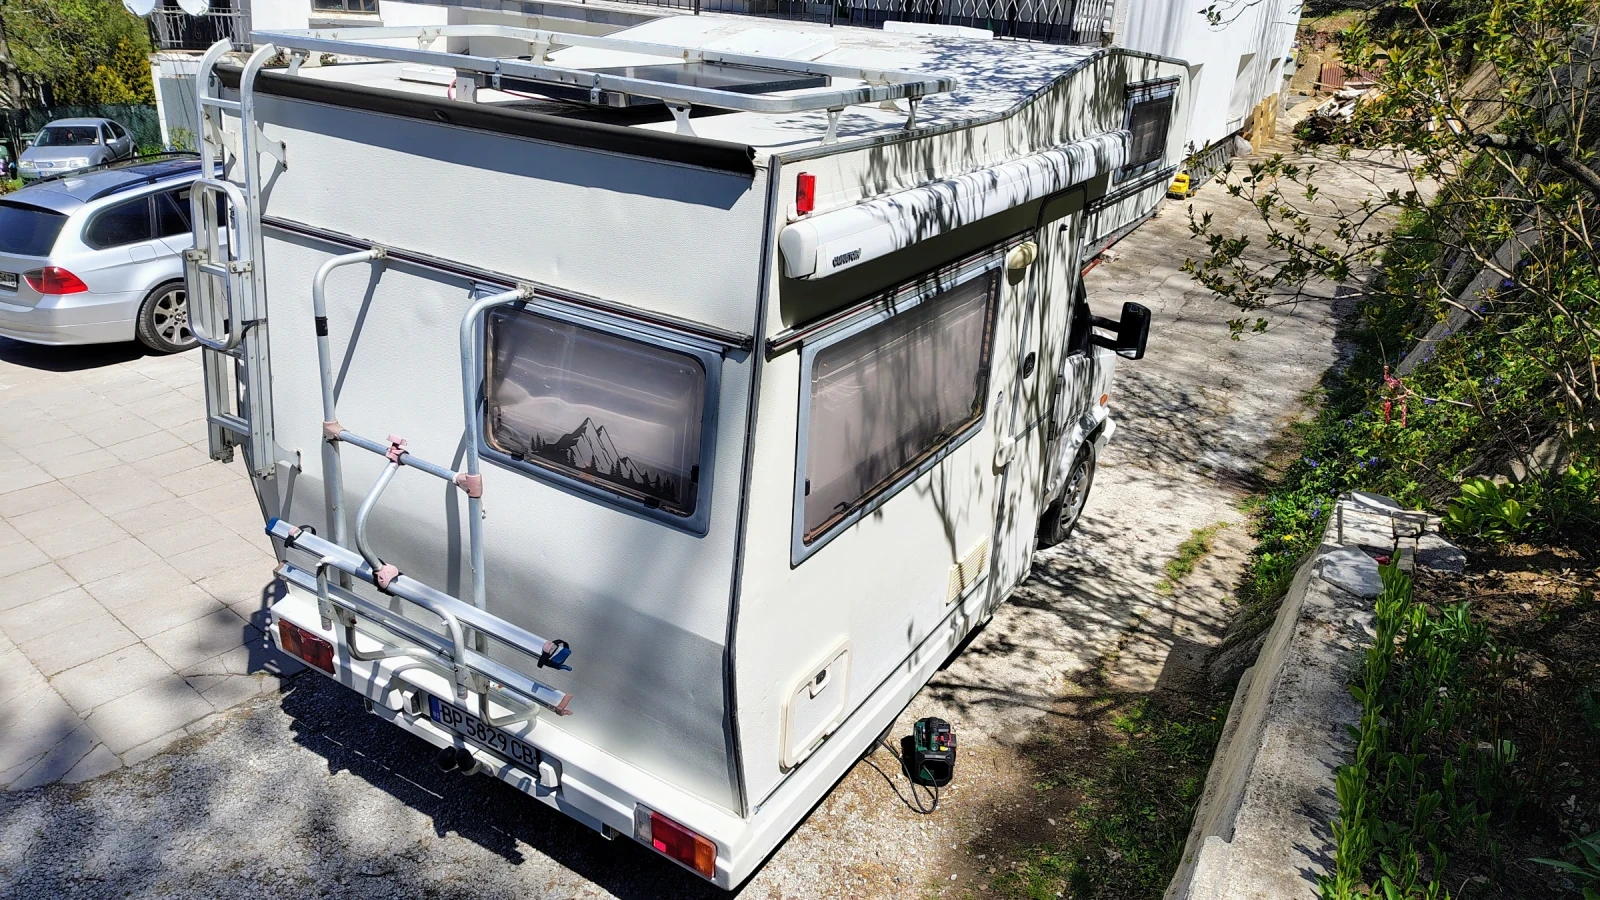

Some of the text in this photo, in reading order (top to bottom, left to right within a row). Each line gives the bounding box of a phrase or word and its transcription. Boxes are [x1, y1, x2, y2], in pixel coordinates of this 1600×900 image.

[441, 704, 536, 766] BP 5829 CB
